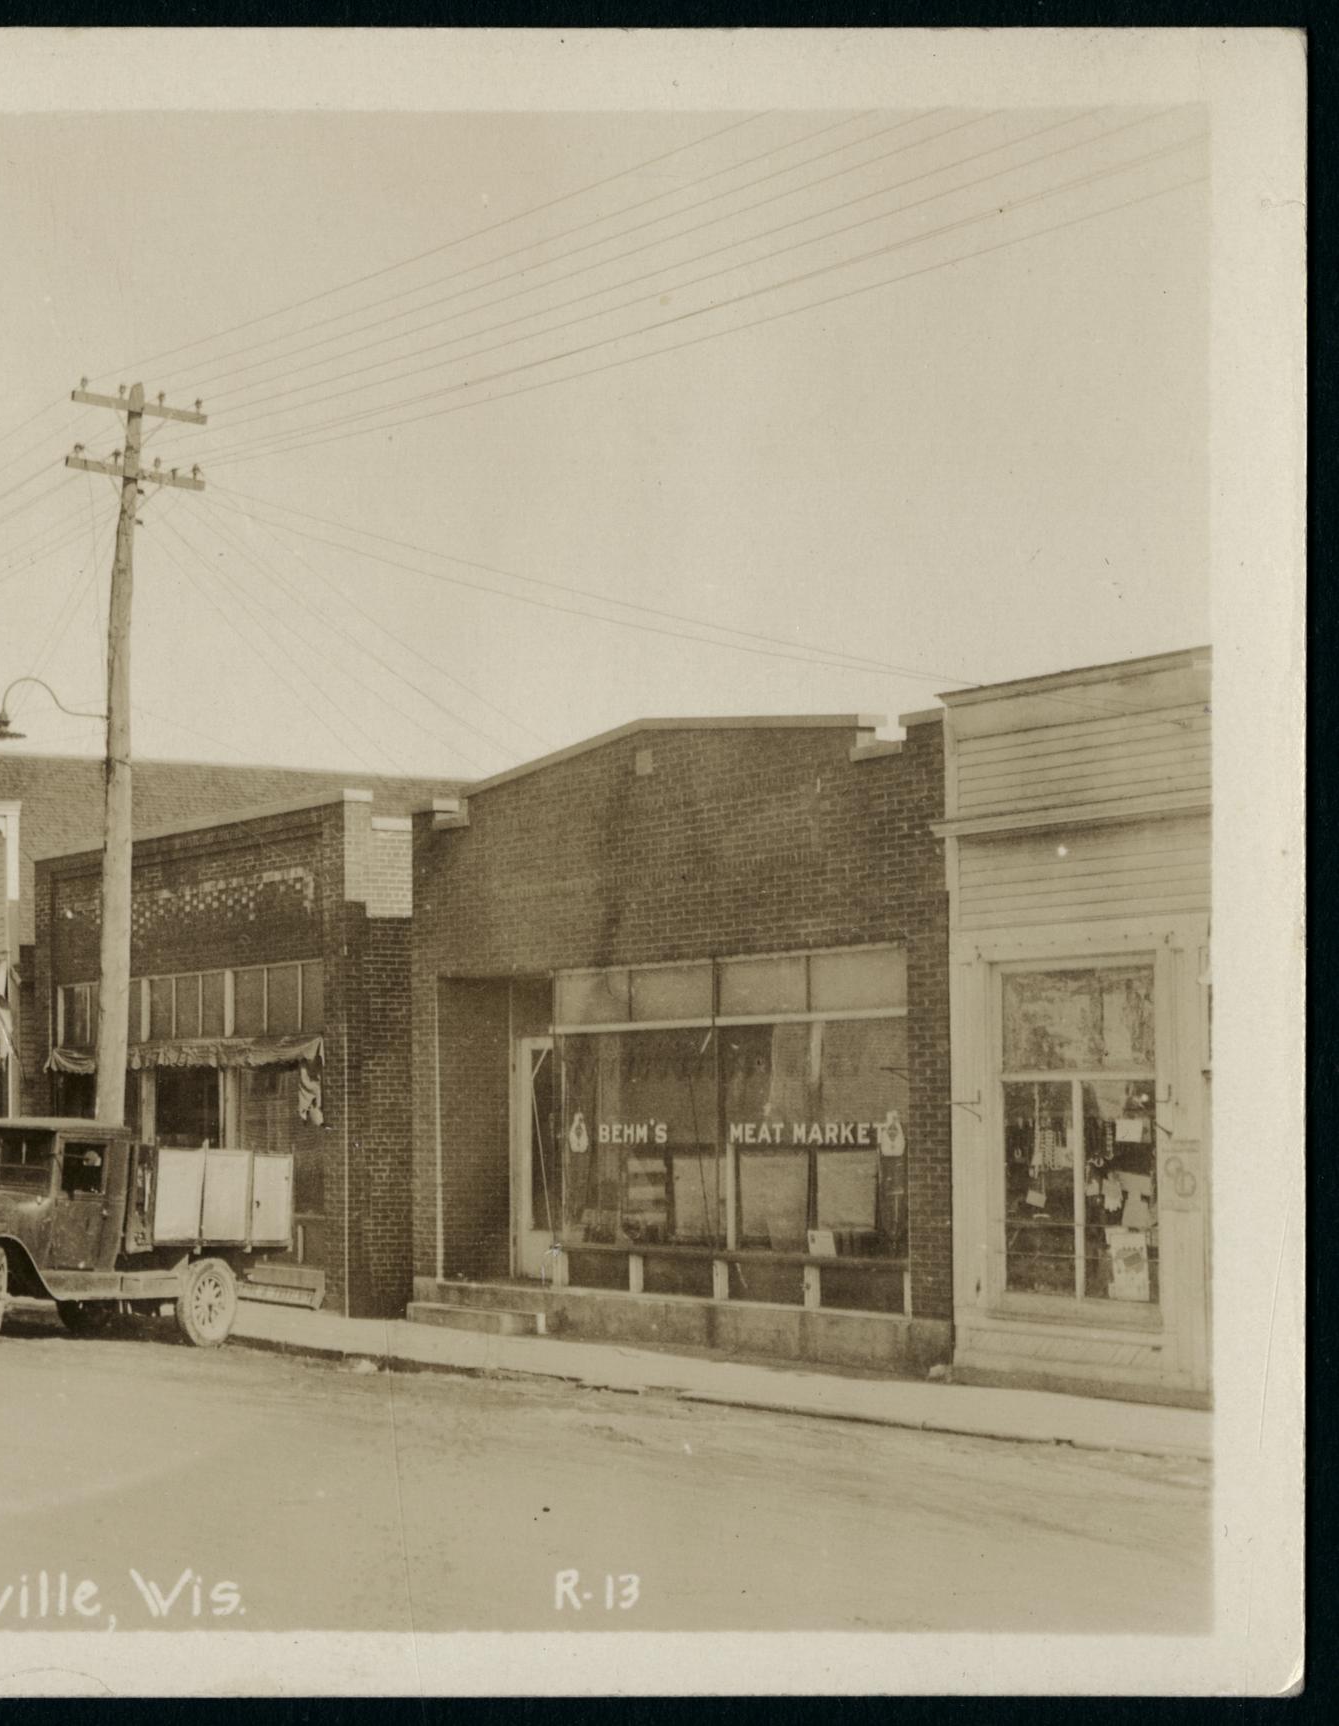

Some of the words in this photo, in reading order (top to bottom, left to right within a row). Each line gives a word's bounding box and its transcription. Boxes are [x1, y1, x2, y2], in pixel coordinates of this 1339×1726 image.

[599, 1118, 668, 1144] BEHM'S
[729, 1122, 784, 1144] MEAT
[792, 1122, 886, 1145] MARKET
